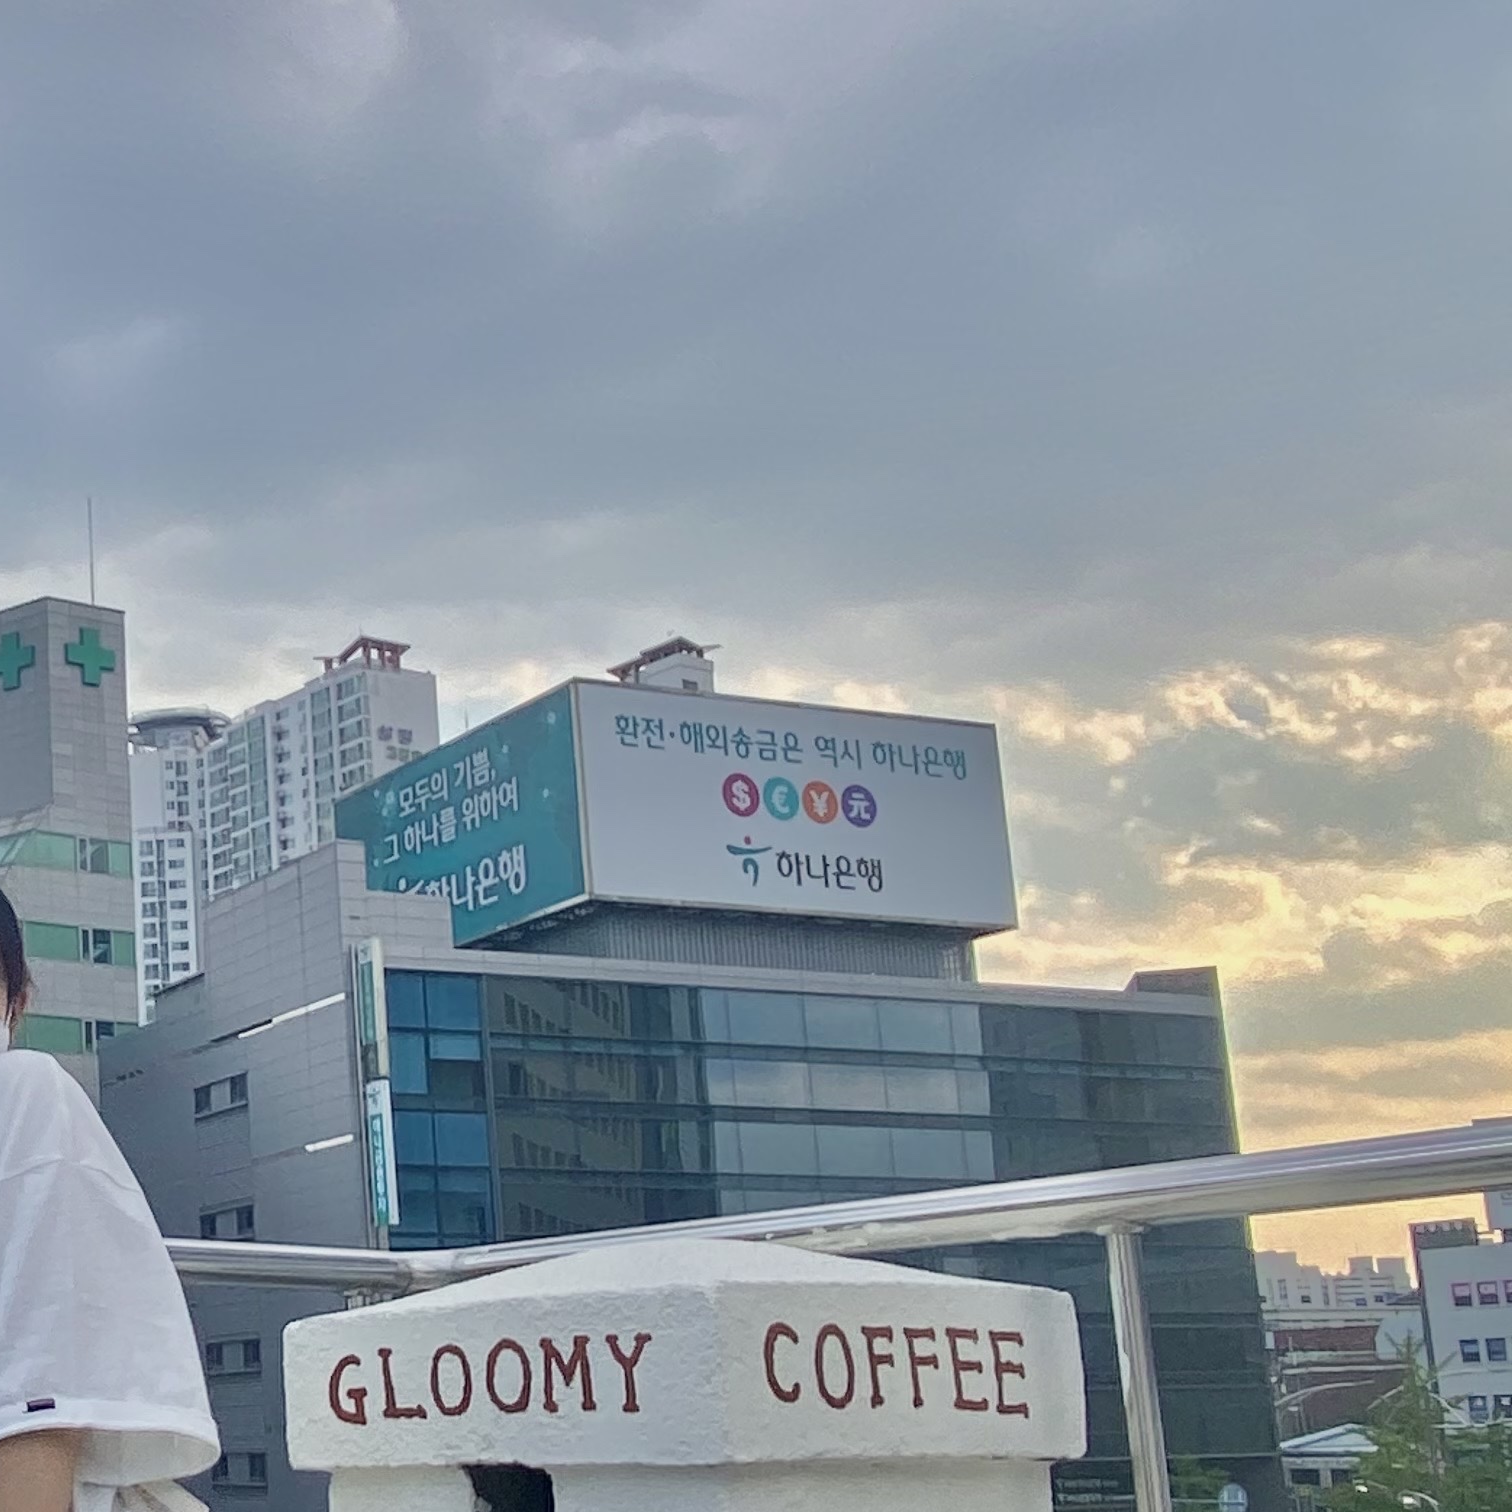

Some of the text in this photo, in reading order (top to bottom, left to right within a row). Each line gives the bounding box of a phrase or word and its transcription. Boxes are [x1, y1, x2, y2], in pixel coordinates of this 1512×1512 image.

[613, 714, 967, 781] 환전·해외송금은 역시 하나은행
[383, 777, 519, 865] 그 하나를 위하여
[398, 771, 449, 819] 모두의
[776, 852, 883, 893] 하나은행
[328, 1321, 1031, 1426] GLOOMY COFFEE
